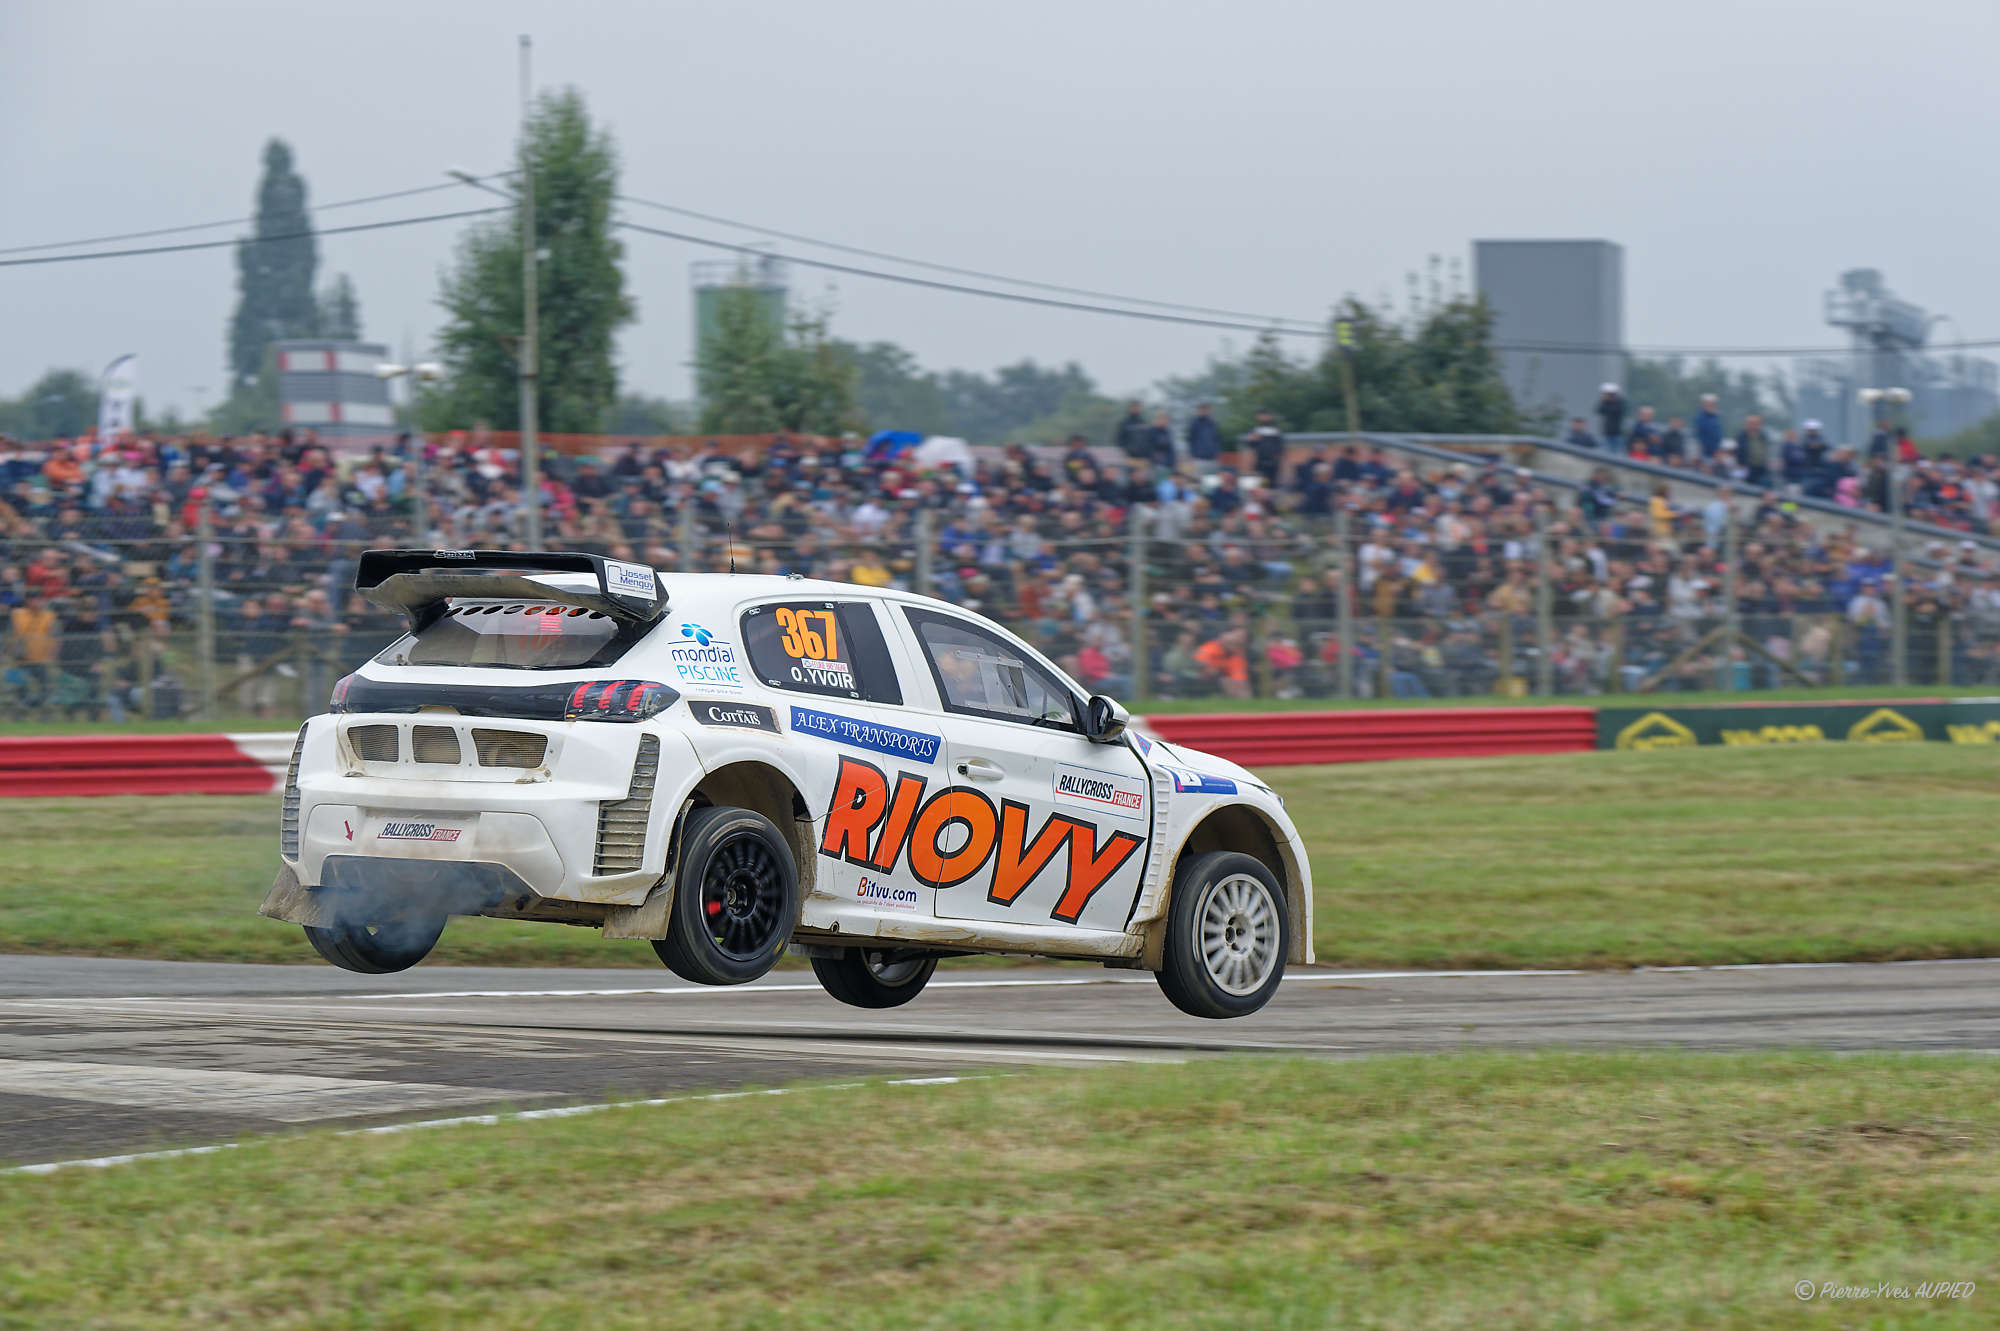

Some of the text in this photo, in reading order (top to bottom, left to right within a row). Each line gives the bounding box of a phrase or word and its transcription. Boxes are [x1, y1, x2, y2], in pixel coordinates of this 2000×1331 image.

[620, 570, 653, 581] Josset
[620, 576, 655, 591] Menguy
[775, 607, 838, 660] 367
[671, 646, 735, 663] mondial
[795, 712, 935, 757] ALEX TRANSPORTS
[1059, 774, 1142, 809] RALLYCROSS FRANCE
[381, 822, 461, 841] RALLYCROSS FRANCE
[818, 753, 1147, 925] RIOVY
